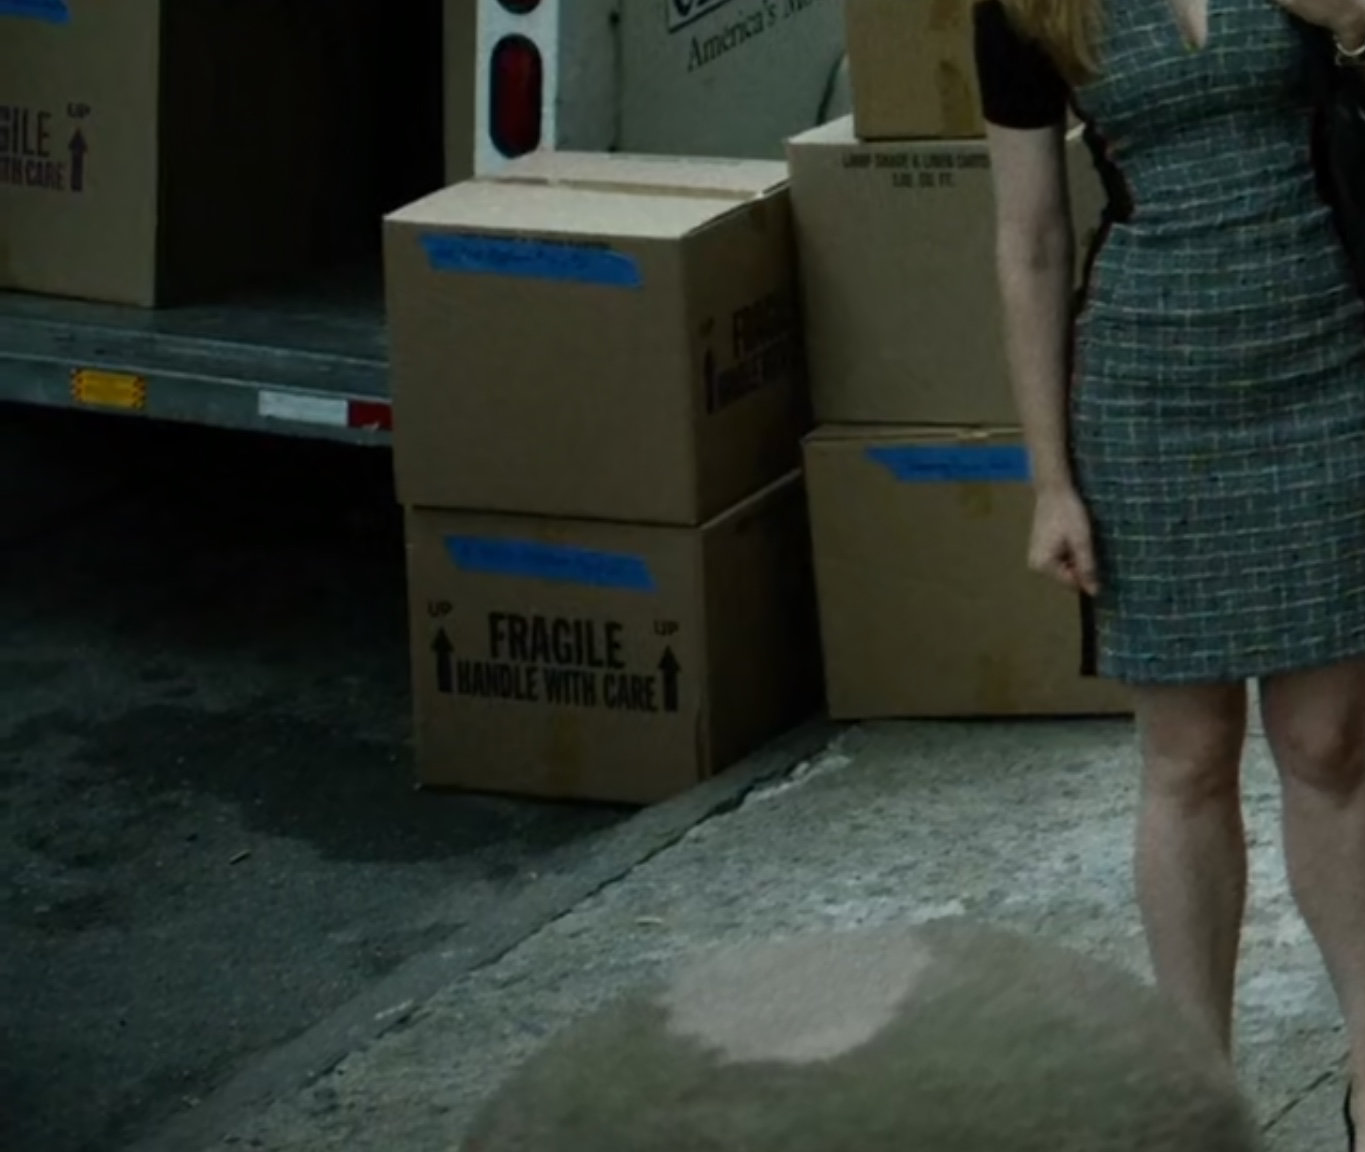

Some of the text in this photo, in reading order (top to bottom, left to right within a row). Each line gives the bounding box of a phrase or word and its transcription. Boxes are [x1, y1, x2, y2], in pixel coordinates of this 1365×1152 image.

[427, 601, 453, 618] UP
[487, 612, 625, 669] FRAGILE
[653, 620, 680, 636] UP
[456, 658, 659, 713] HANDLE WITH CARE
